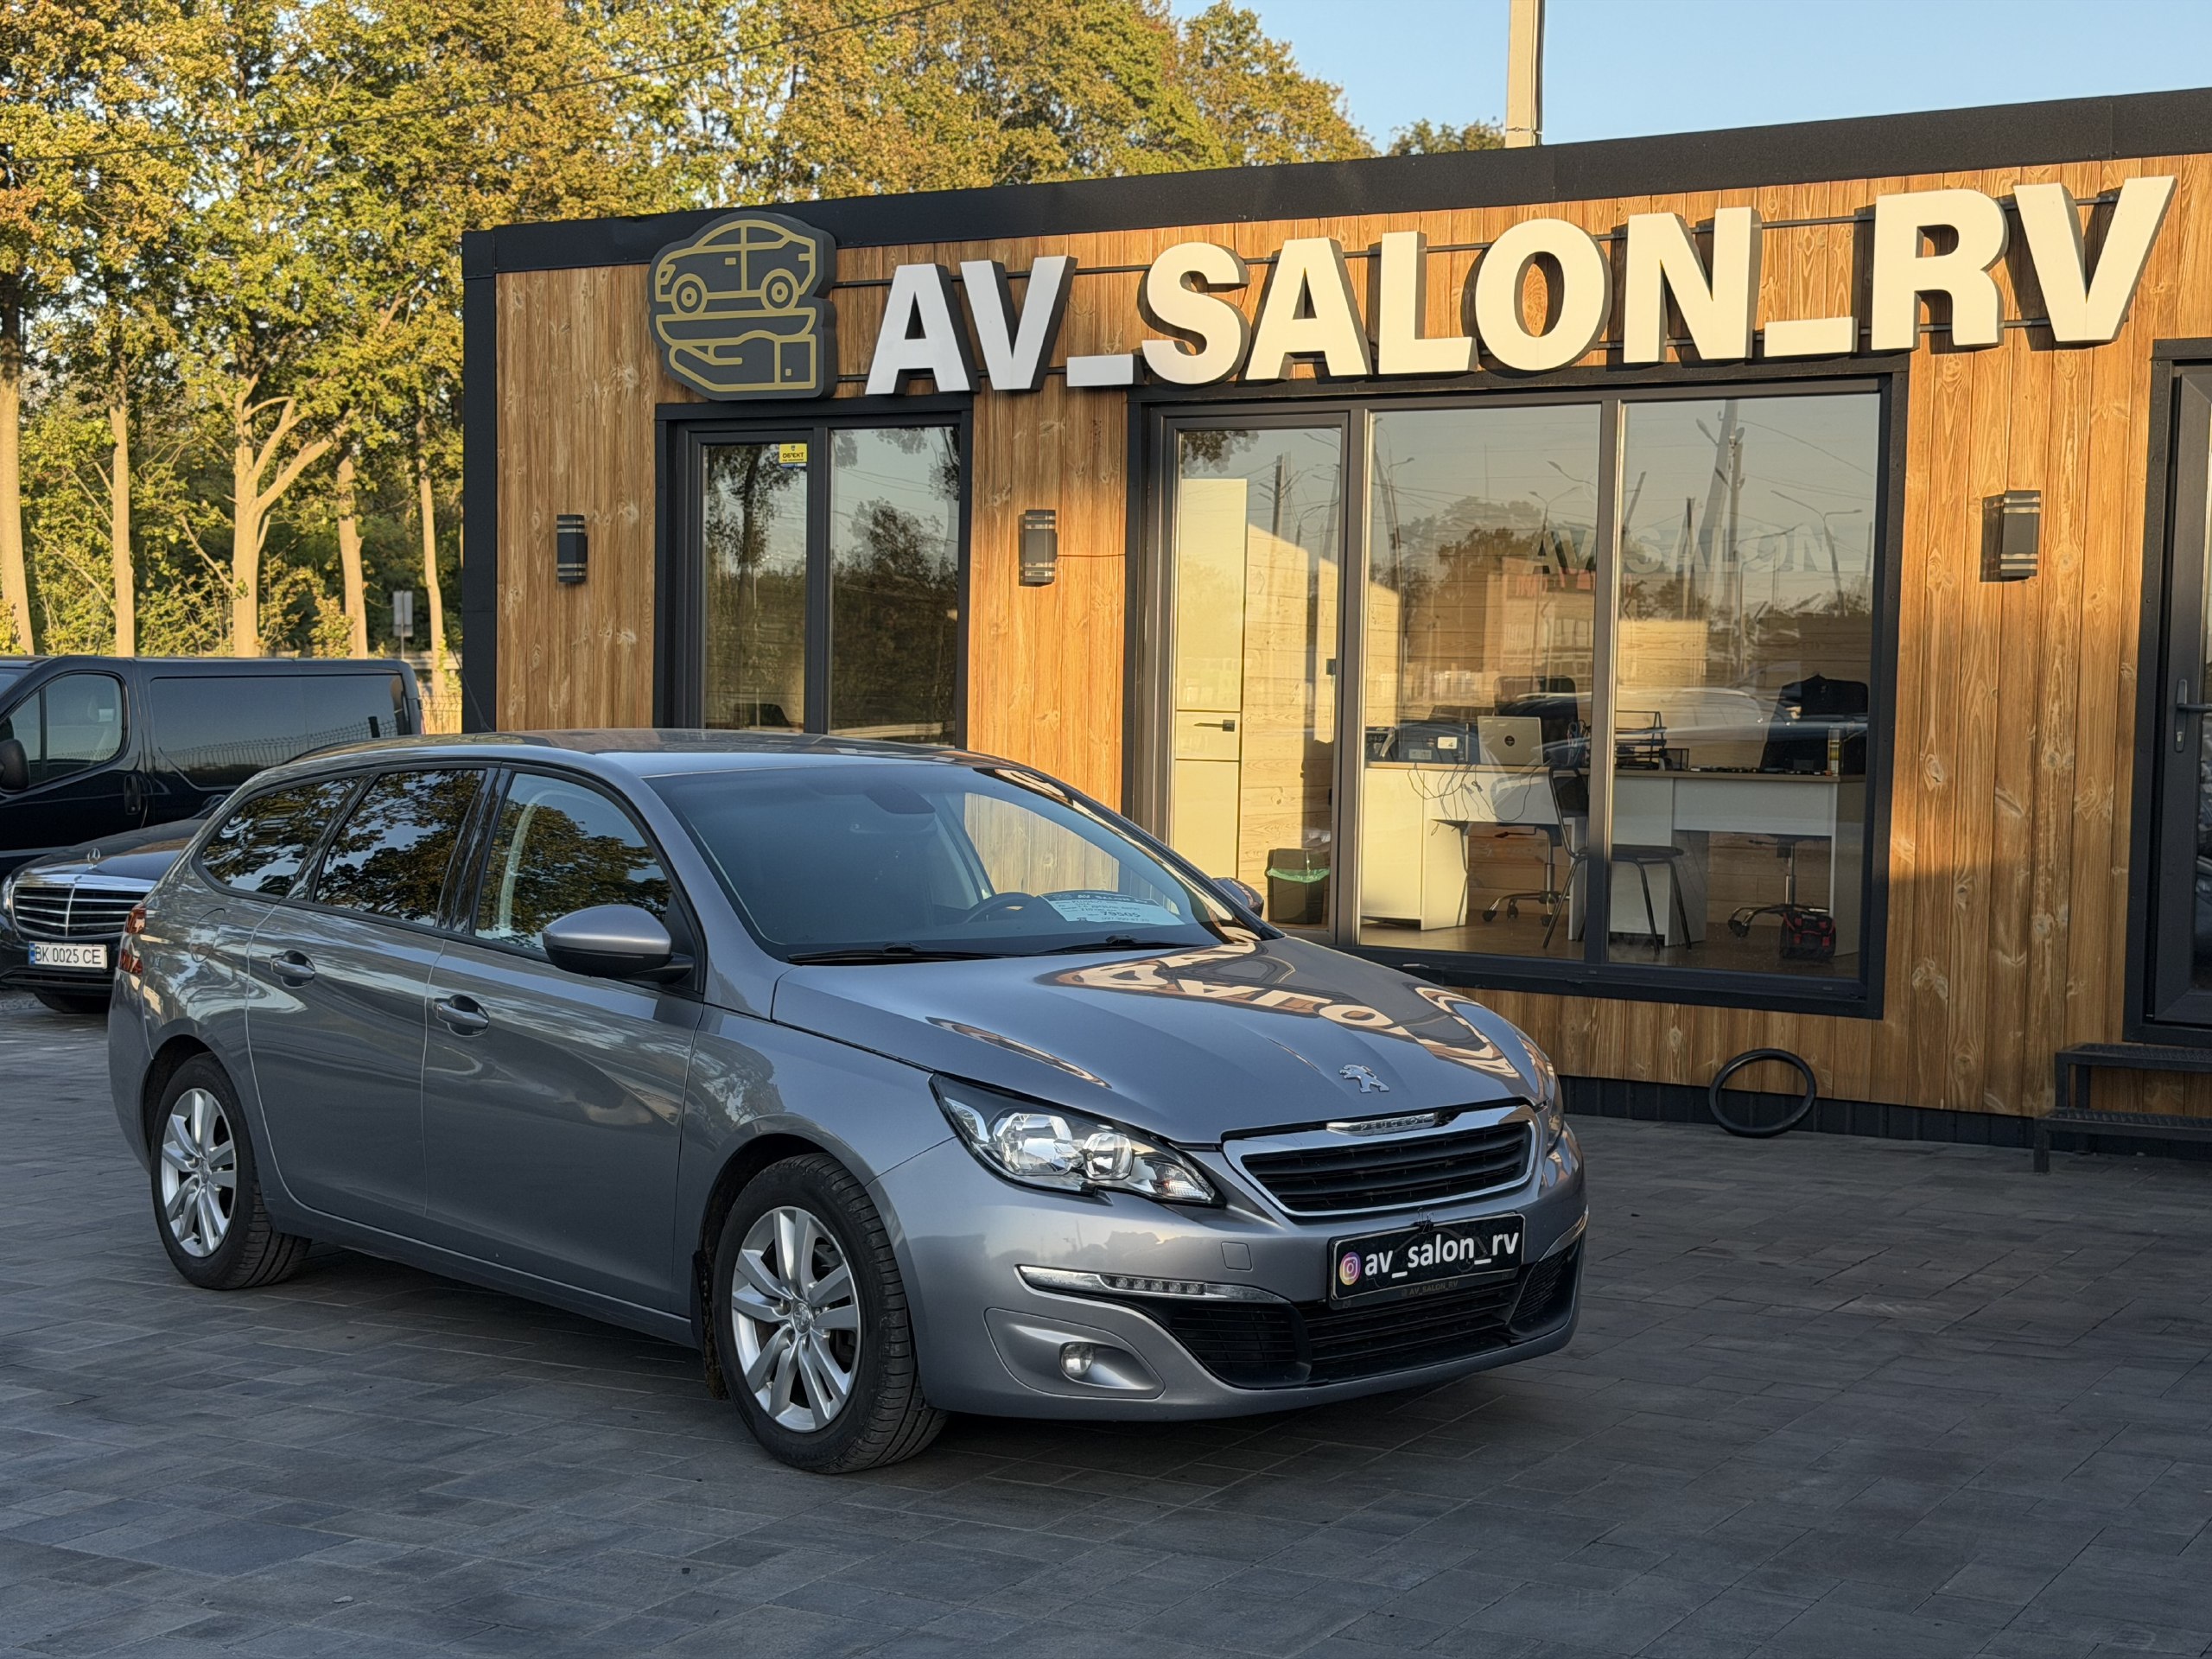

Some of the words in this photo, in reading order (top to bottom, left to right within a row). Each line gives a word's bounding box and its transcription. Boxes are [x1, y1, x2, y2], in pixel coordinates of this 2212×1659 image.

[864, 175, 2176, 394] AV_SALON_RV
[35, 945, 50, 963] BK
[52, 947, 79, 964] 0025
[82, 949, 102, 965] CE
[1360, 1115, 1427, 1131] PEUGEOT
[1364, 1232, 1519, 1279] av_salon_rv
[1408, 1280, 1459, 1296] AV_SALON_RV
